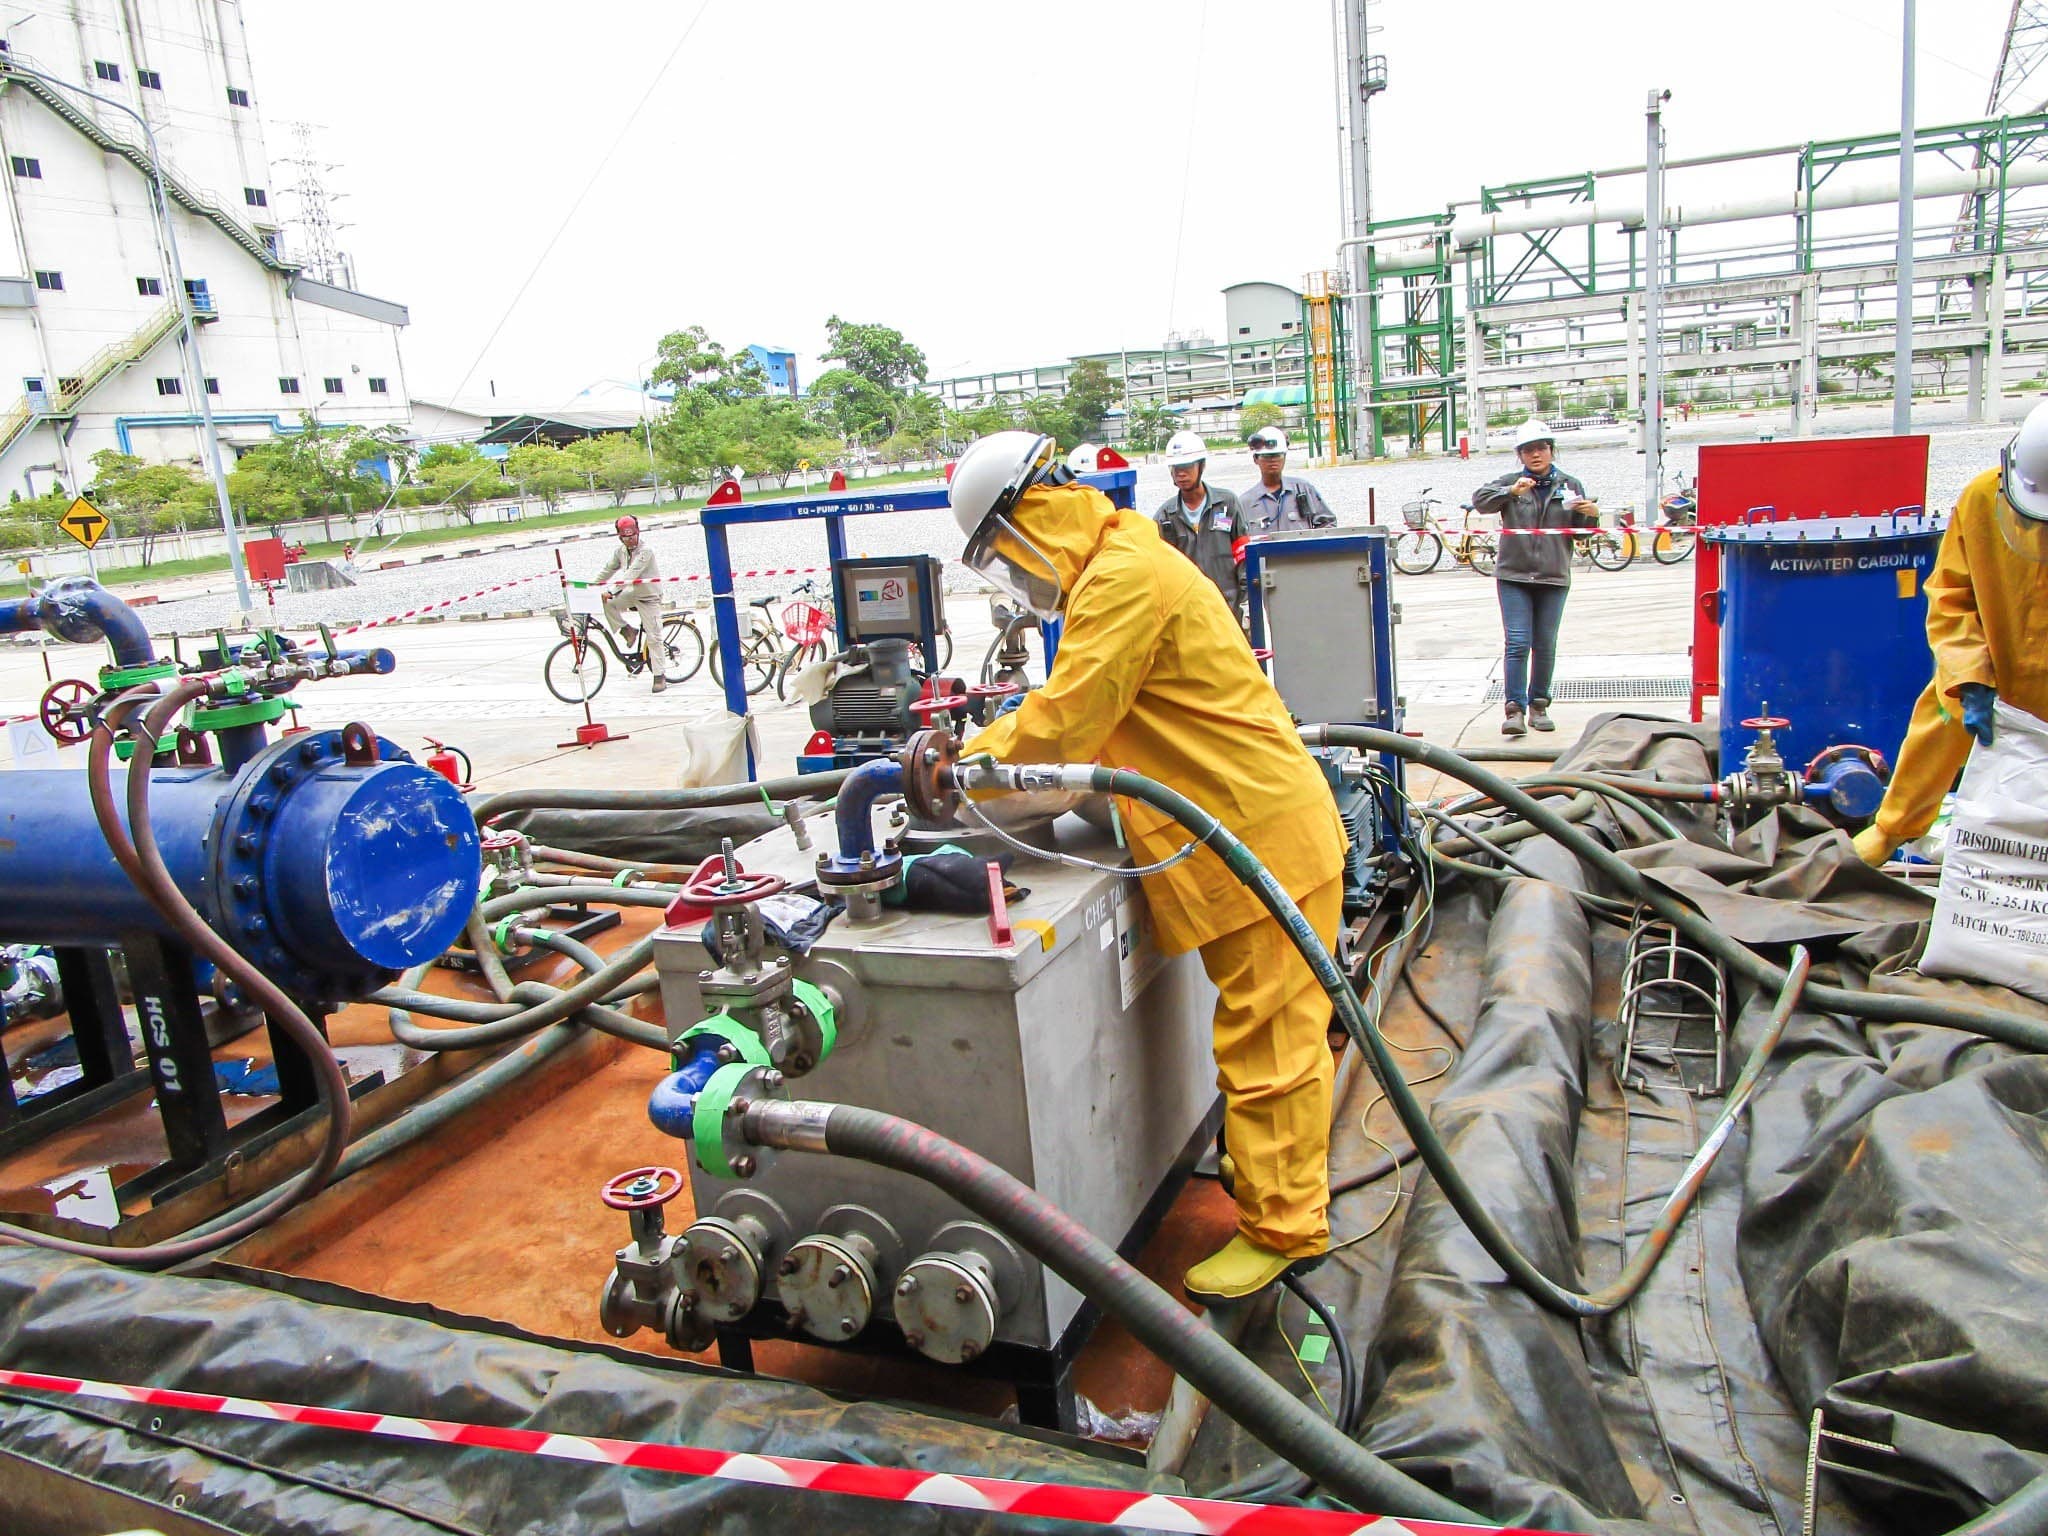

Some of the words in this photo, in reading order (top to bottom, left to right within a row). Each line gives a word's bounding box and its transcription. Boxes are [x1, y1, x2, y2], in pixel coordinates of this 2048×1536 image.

[816, 504, 840, 514] PUMP
[883, 503, 894, 512] 02
[1770, 557, 1853, 571] ACTIVATED
[1857, 554, 1909, 570] CABON
[1955, 828, 2028, 859] TRISODIUM
[2007, 874, 2048, 893] 25.0K
[1085, 895, 1107, 930] CHE
[1951, 912, 1988, 933] BATCH
[144, 996, 170, 1047] HCS
[159, 1057, 182, 1091] 01
